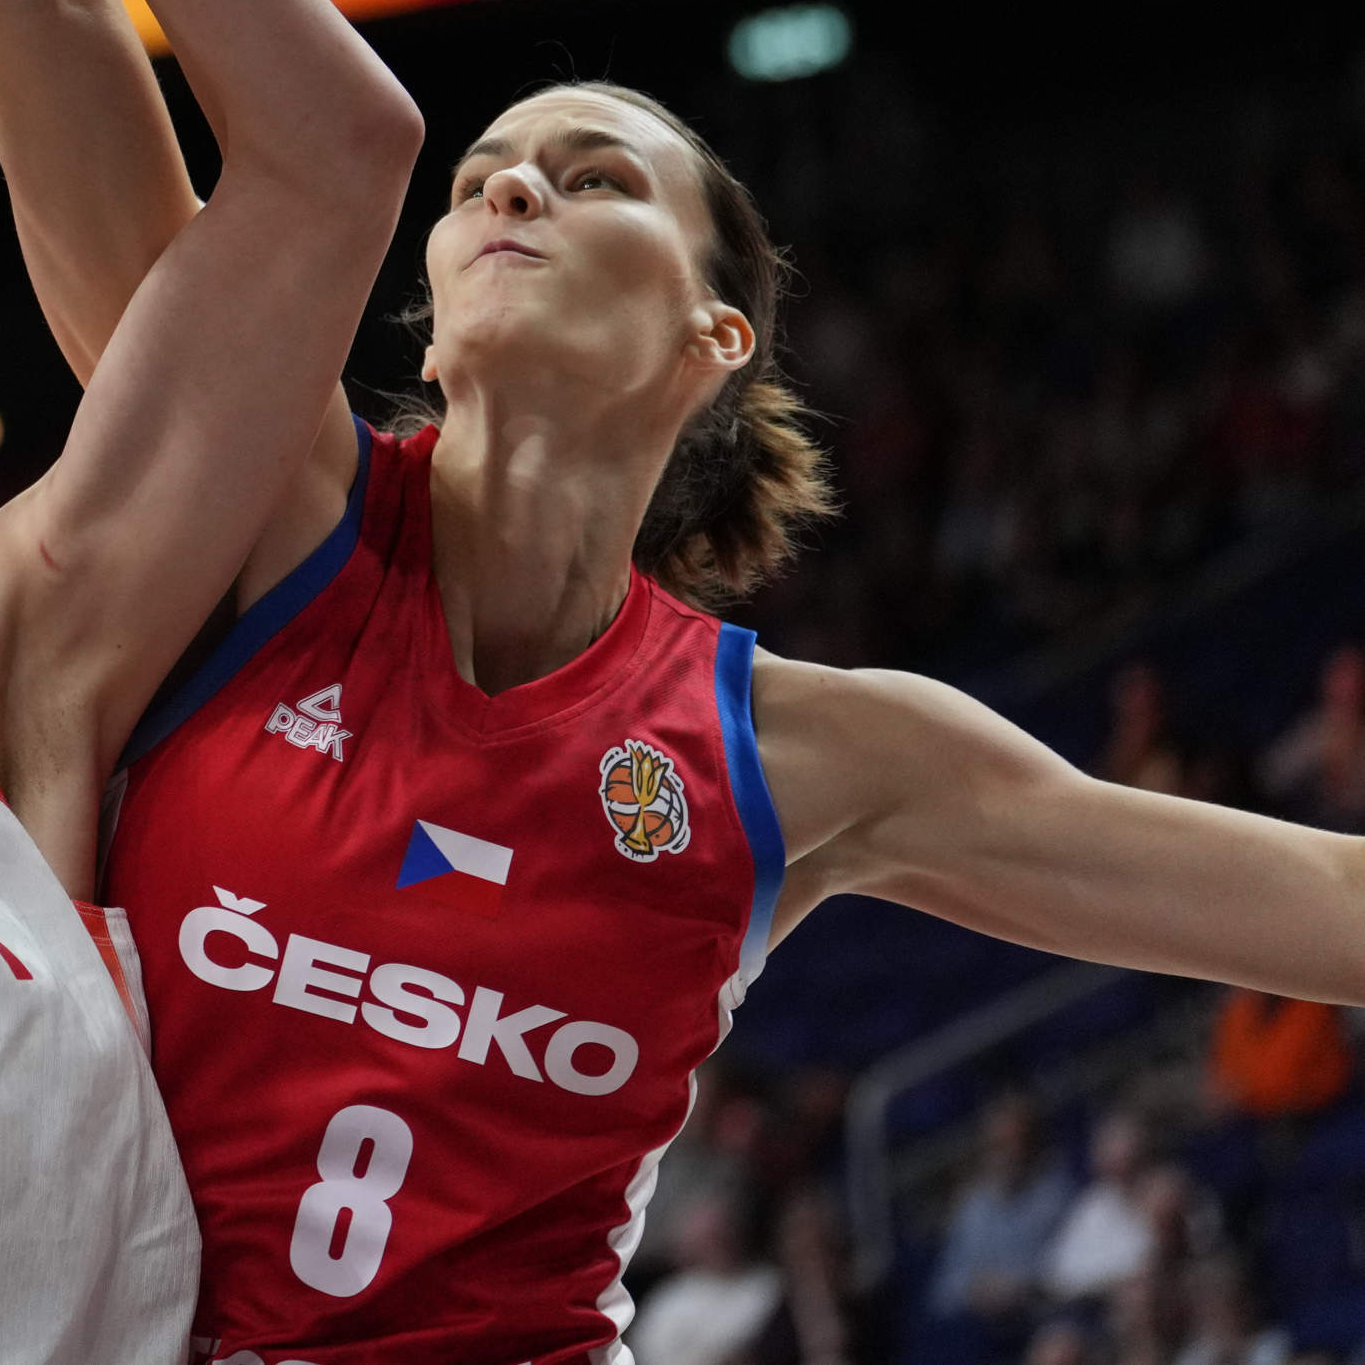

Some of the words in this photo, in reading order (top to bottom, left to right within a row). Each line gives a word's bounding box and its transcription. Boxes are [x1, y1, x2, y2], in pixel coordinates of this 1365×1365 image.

[264, 702, 353, 762] PEAK
[177, 885, 640, 1097] ČESKO
[288, 1104, 414, 1298] 8
